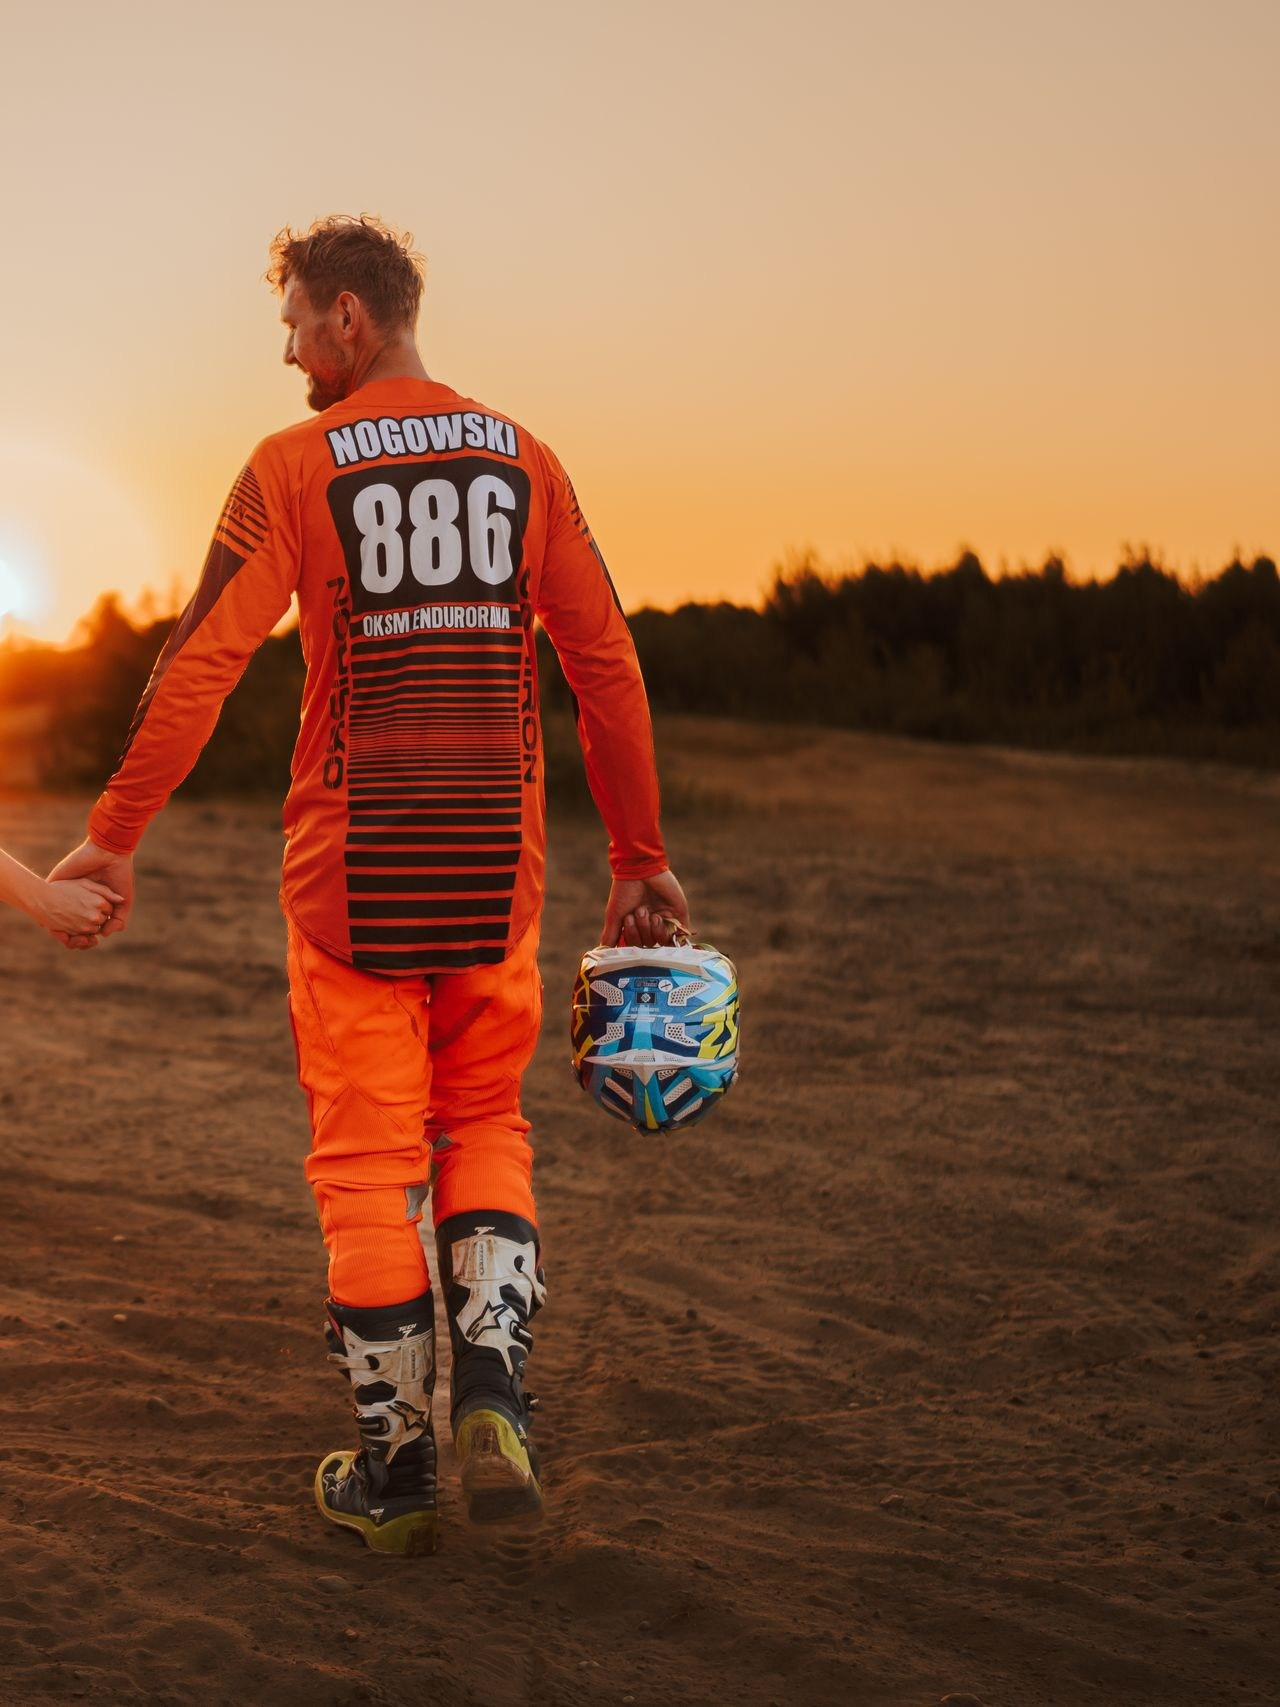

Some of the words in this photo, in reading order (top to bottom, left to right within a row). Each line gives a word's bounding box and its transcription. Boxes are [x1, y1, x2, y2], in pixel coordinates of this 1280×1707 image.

[327, 411, 517, 467] NOGOWSKI
[352, 474, 516, 594] 886
[362, 611, 410, 638] OKSM
[412, 605, 511, 631] ENDURORANA
